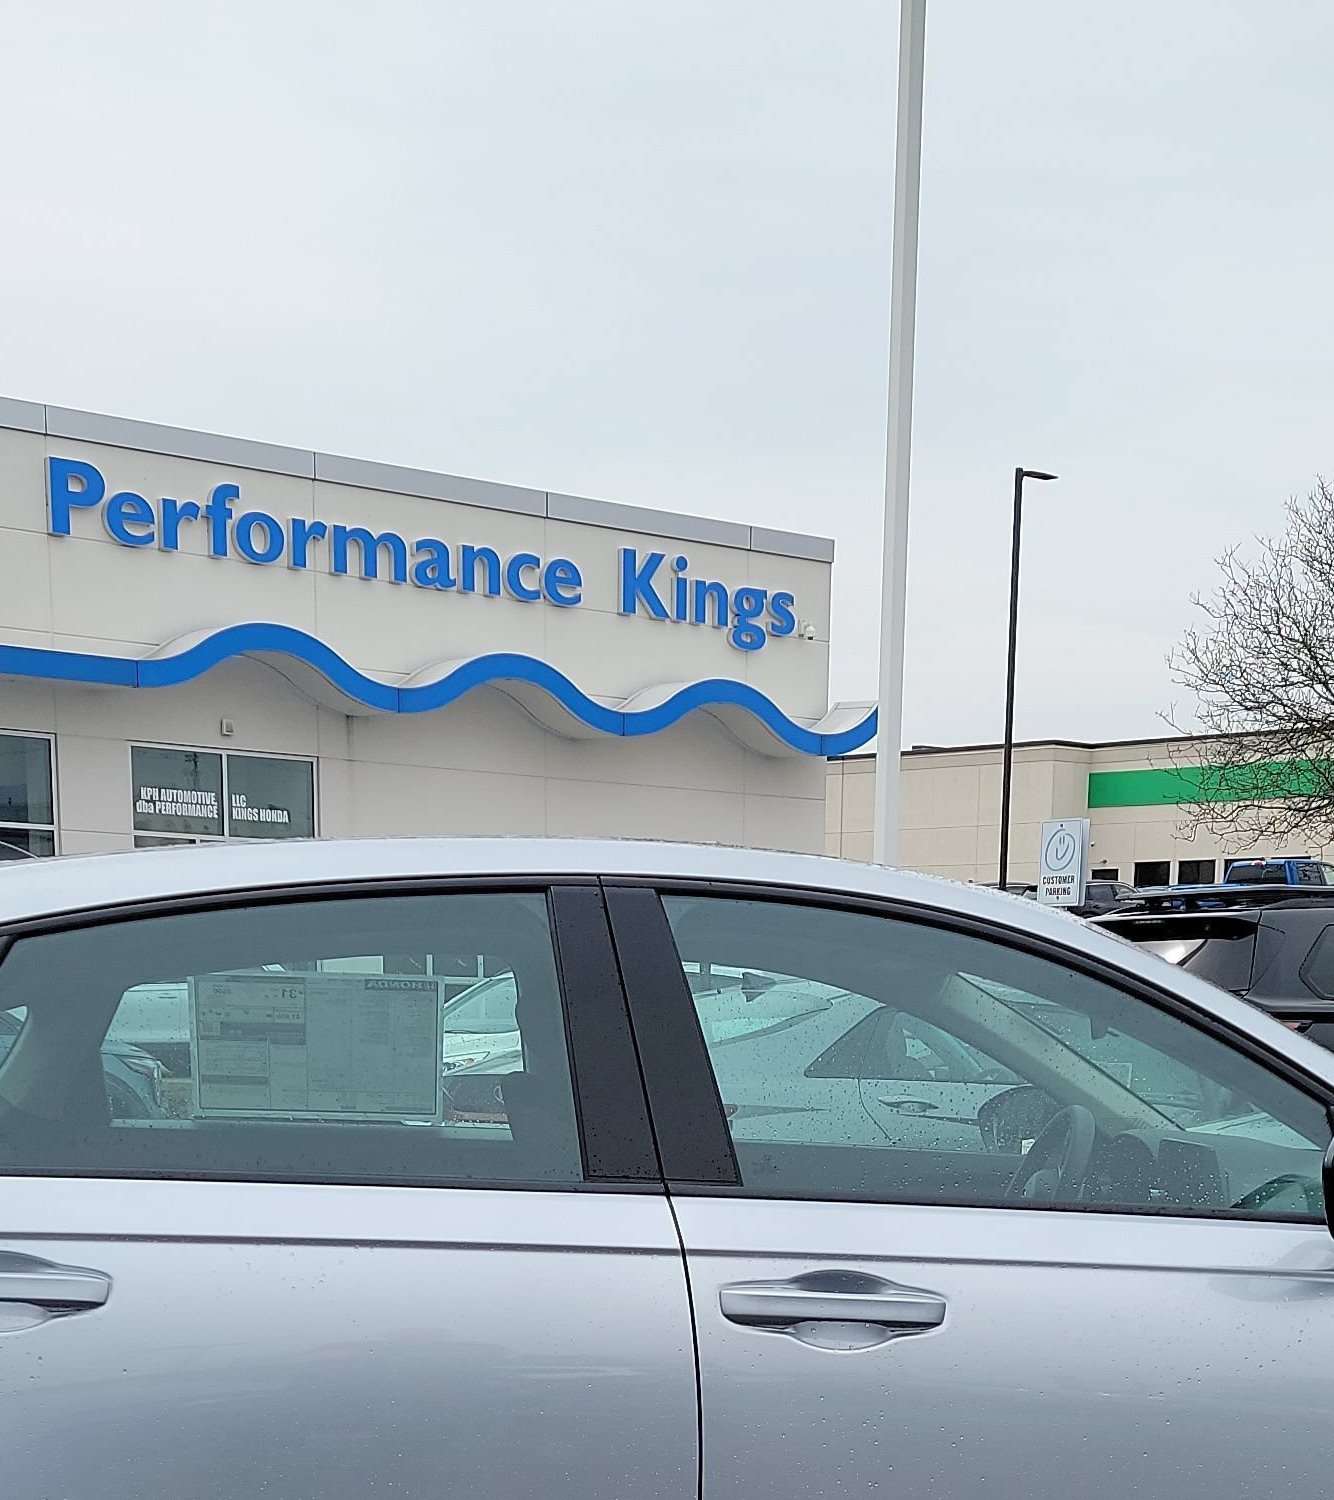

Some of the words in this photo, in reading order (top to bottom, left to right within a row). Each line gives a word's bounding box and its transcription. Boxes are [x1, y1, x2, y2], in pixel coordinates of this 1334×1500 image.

[45, 455, 583, 608] Performance
[617, 546, 796, 651] Kings
[140, 786, 159, 801] KPH
[160, 788, 218, 805] AUTOMOTIVE
[231, 793, 247, 807] LLC
[136, 800, 154, 813] dba
[155, 801, 218, 818] PERFORMANCE
[232, 807, 259, 821] KINGS
[259, 808, 289, 823] HONDA
[1043, 875, 1075, 885] CUSTOMER
[1045, 886, 1071, 896] PARKING
